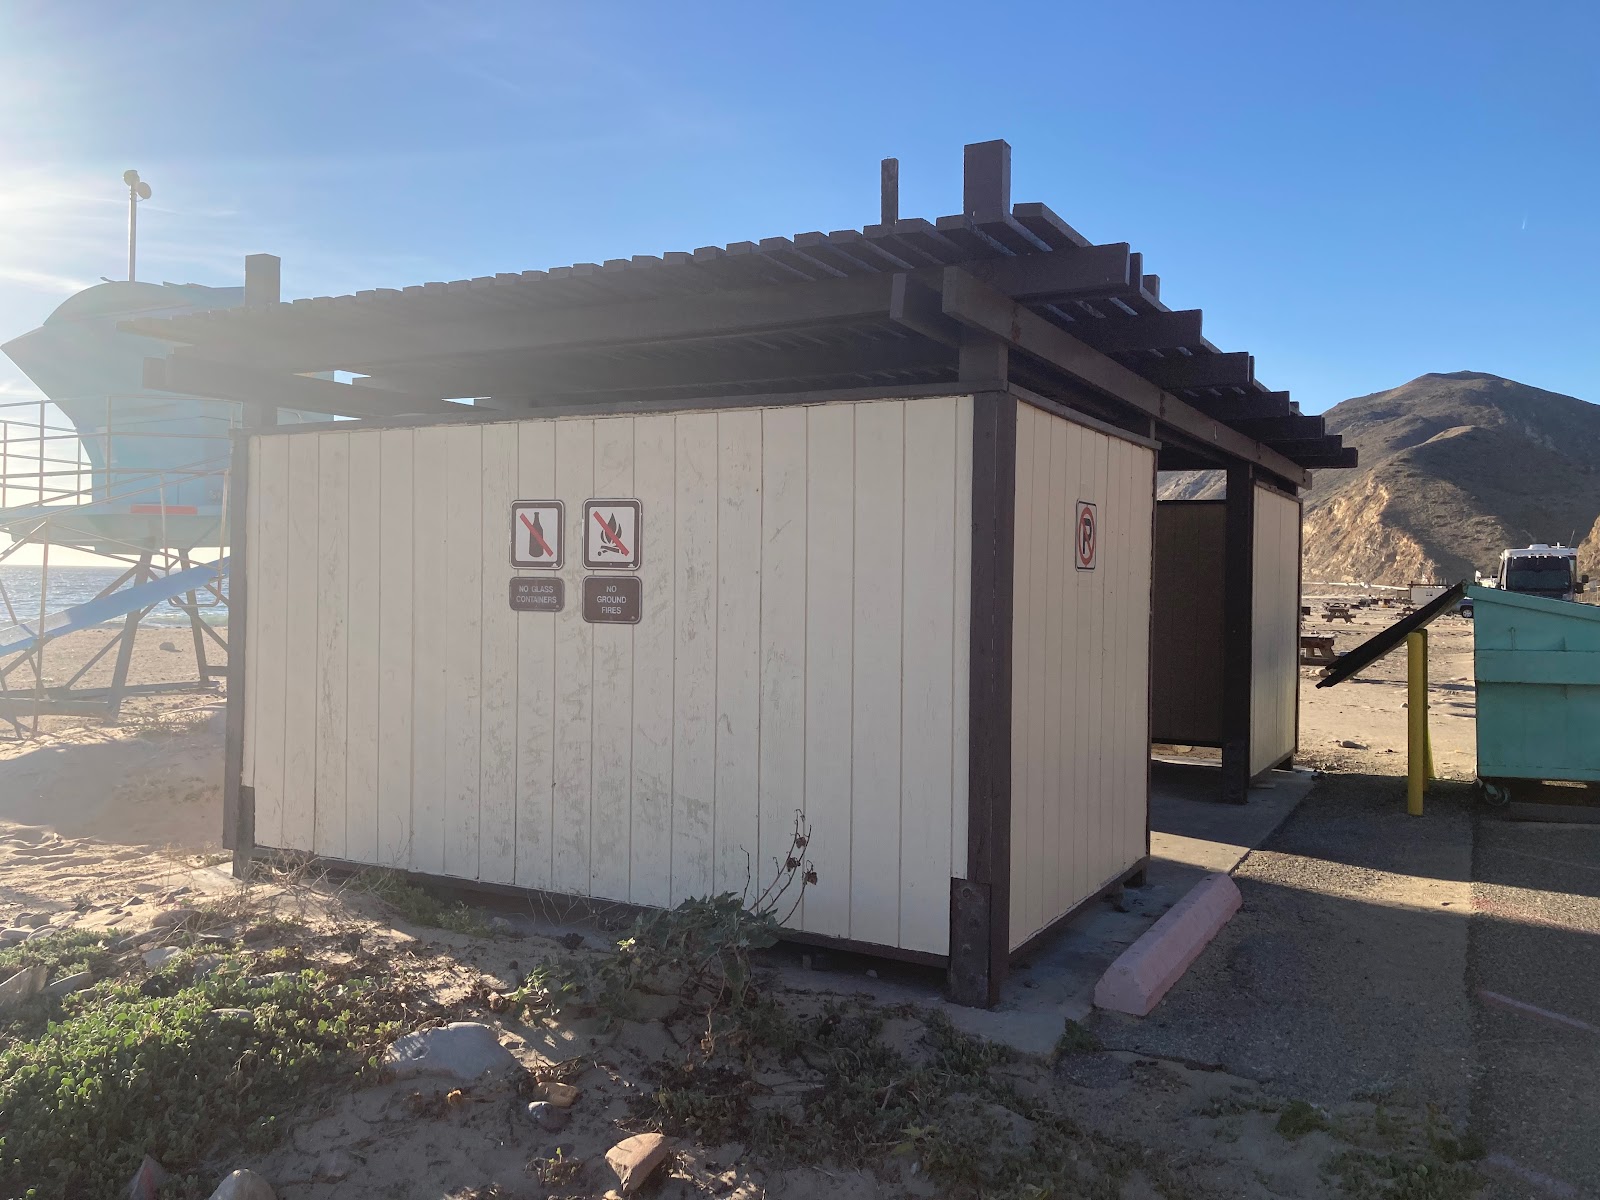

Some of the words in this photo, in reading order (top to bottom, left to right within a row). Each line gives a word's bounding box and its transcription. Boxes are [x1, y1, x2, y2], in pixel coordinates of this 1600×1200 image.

[518, 585, 529, 593] NO
[531, 585, 554, 593] GLASS
[606, 585, 617, 593] NO
[516, 595, 557, 604] CONTAINERS
[596, 595, 627, 604] GROUND
[601, 606, 622, 614] FIRES
